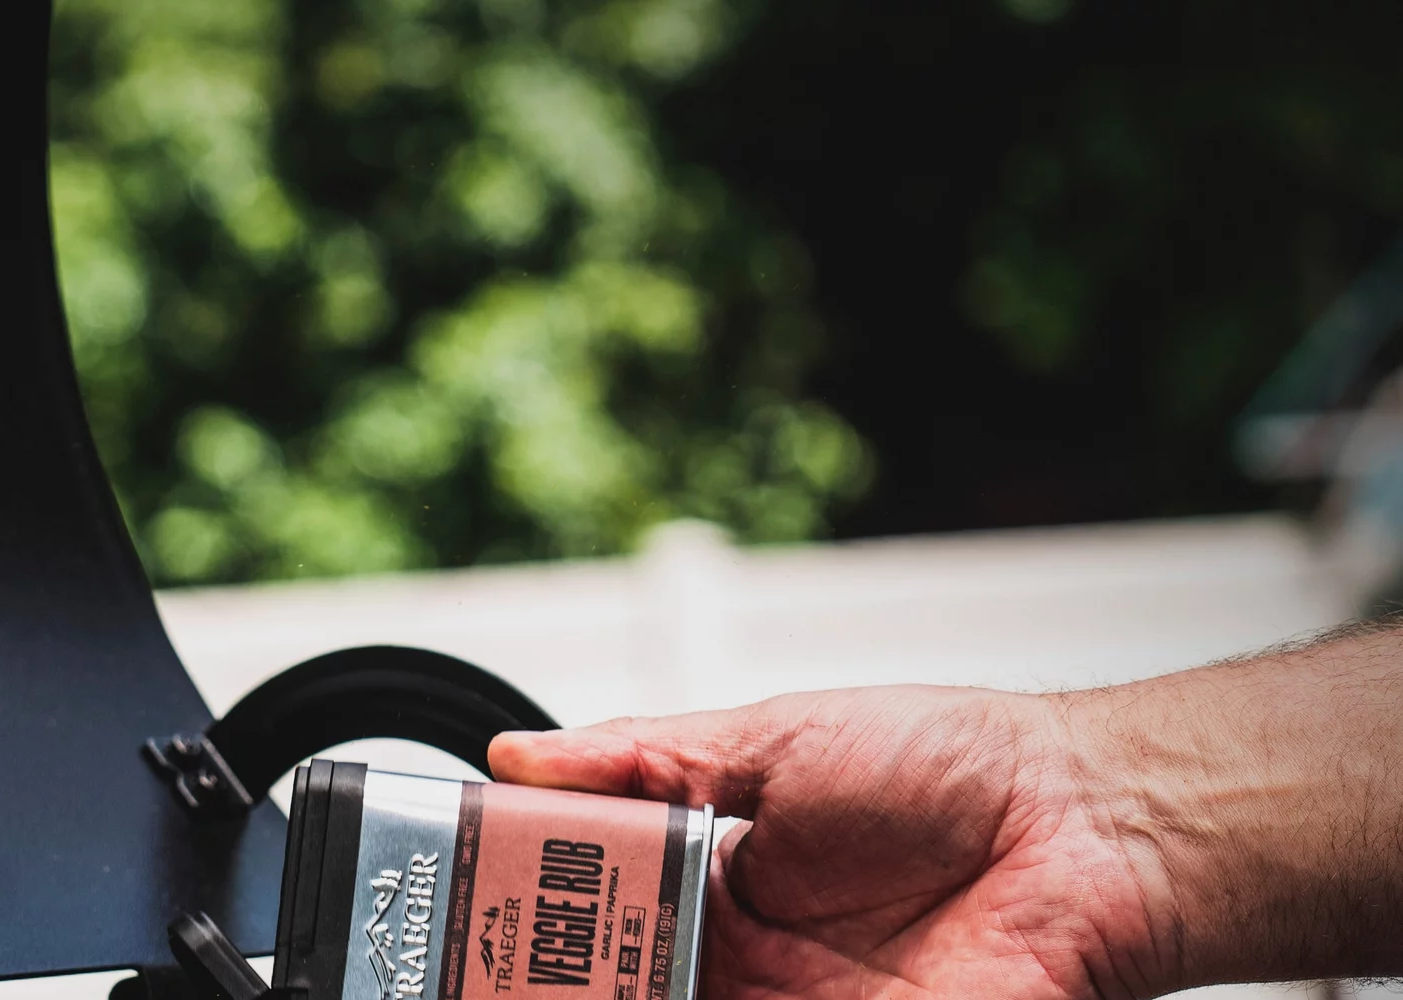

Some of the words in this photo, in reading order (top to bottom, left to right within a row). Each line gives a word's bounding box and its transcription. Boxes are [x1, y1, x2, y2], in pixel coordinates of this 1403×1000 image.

[464, 823, 475, 844] FREE
[458, 876, 469, 899] FREE
[538, 838, 605, 896] RUB
[606, 866, 620, 914] PAPRIKA
[454, 900, 466, 930] GLUTEN
[658, 902, 675, 938] (191G)
[495, 897, 522, 994] TRAEGER
[527, 895, 599, 986] VEGGIE
[600, 919, 614, 960] GARLIC
[446, 943, 461, 997] INGREDIENTS
[654, 958, 667, 983] 6.75
